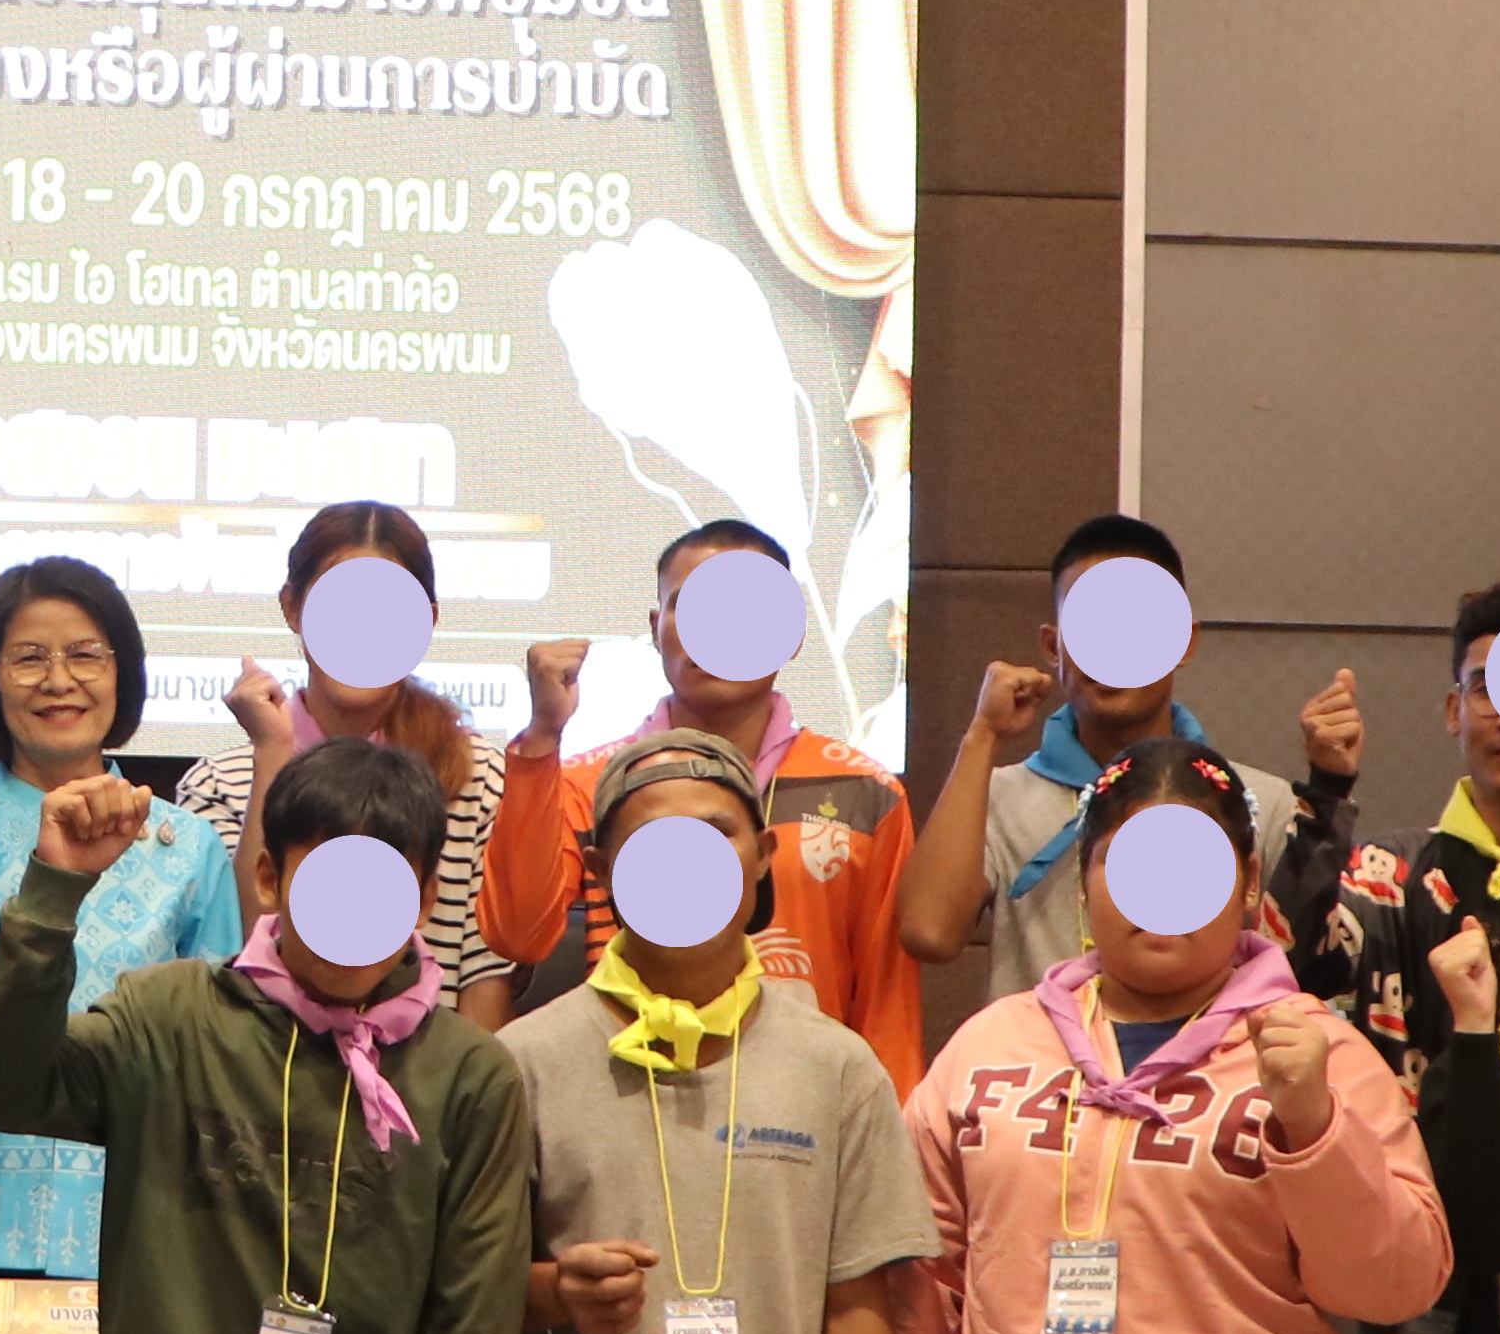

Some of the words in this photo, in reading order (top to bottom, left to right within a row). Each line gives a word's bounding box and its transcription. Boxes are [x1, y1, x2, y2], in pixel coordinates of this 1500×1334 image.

[1, 158, 68, 224] 18
[130, 160, 205, 228] 20
[222, 174, 470, 248] กรกฎาคม
[484, 170, 632, 239] 2568
[70, 247, 115, 306] ไอ
[126, 251, 240, 310] โฮเทล
[250, 251, 460, 314] ตำบลท่าค้อ
[210, 313, 513, 376] จังหวัดนครพนม
